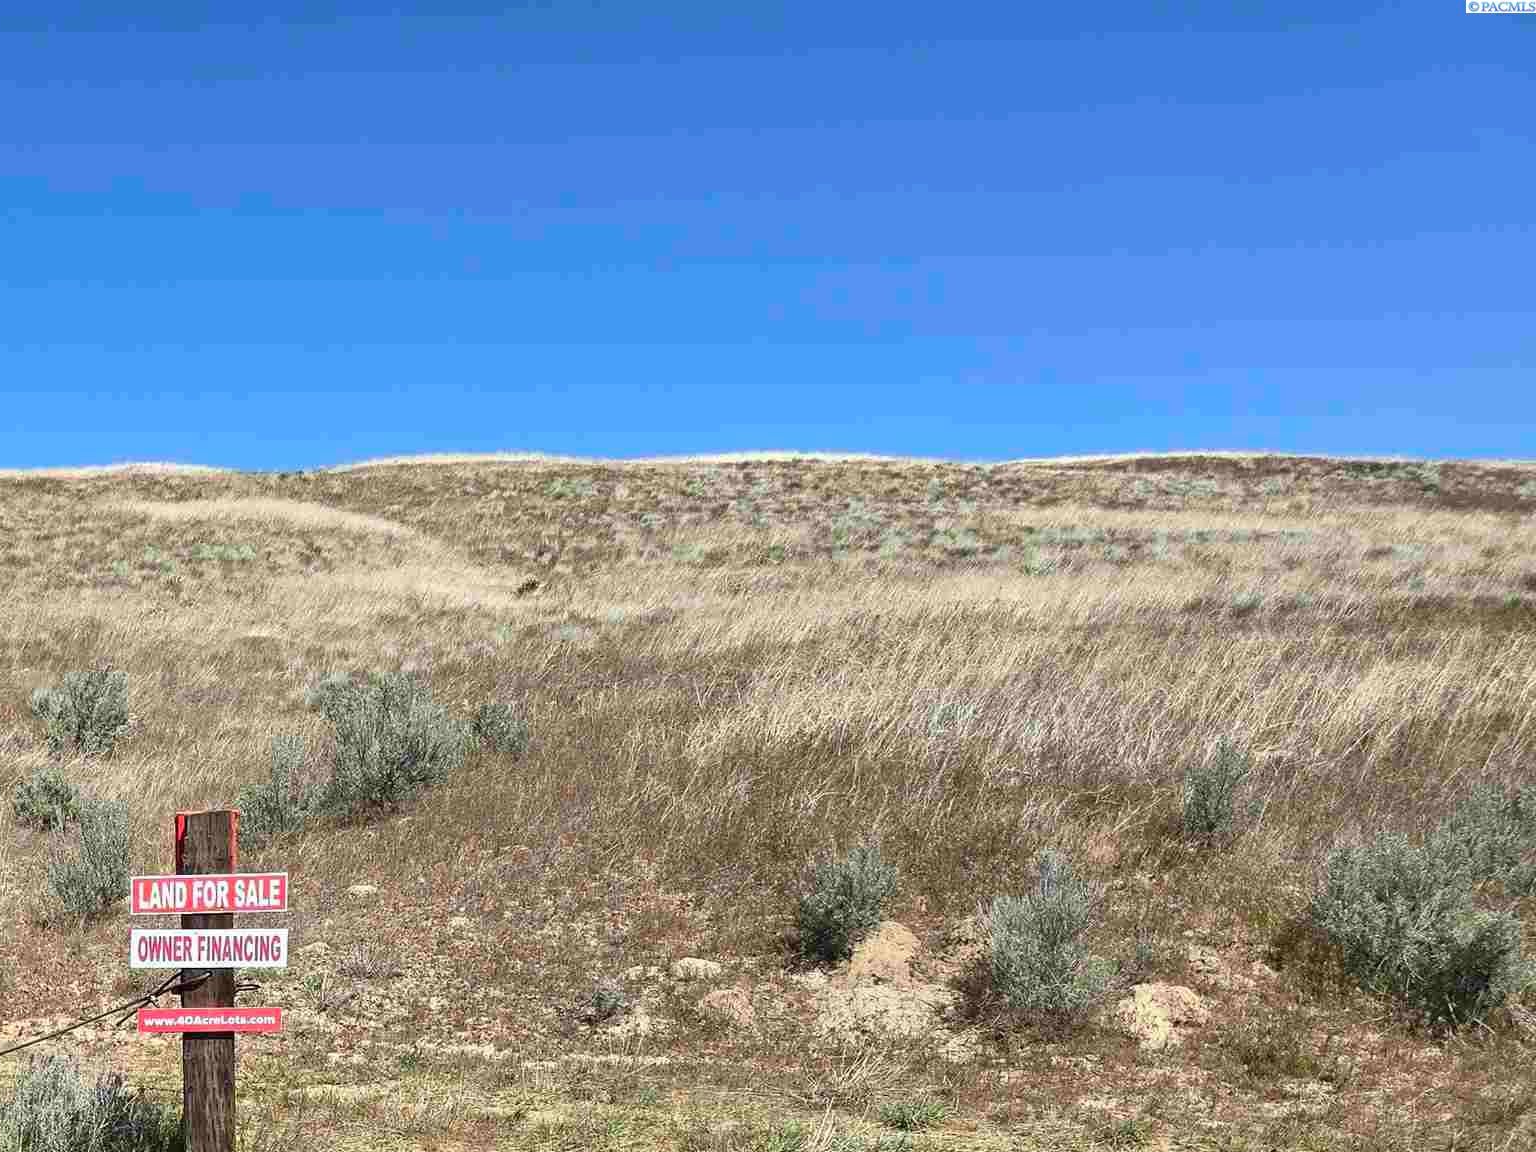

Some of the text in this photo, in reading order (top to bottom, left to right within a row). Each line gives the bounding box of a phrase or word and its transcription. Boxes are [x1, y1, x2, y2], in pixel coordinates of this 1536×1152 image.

[138, 879, 281, 909] LAND FOR SALE
[138, 935, 281, 962] OWNER FINANCING
[143, 1014, 275, 1026] www.40AcreLots.com
